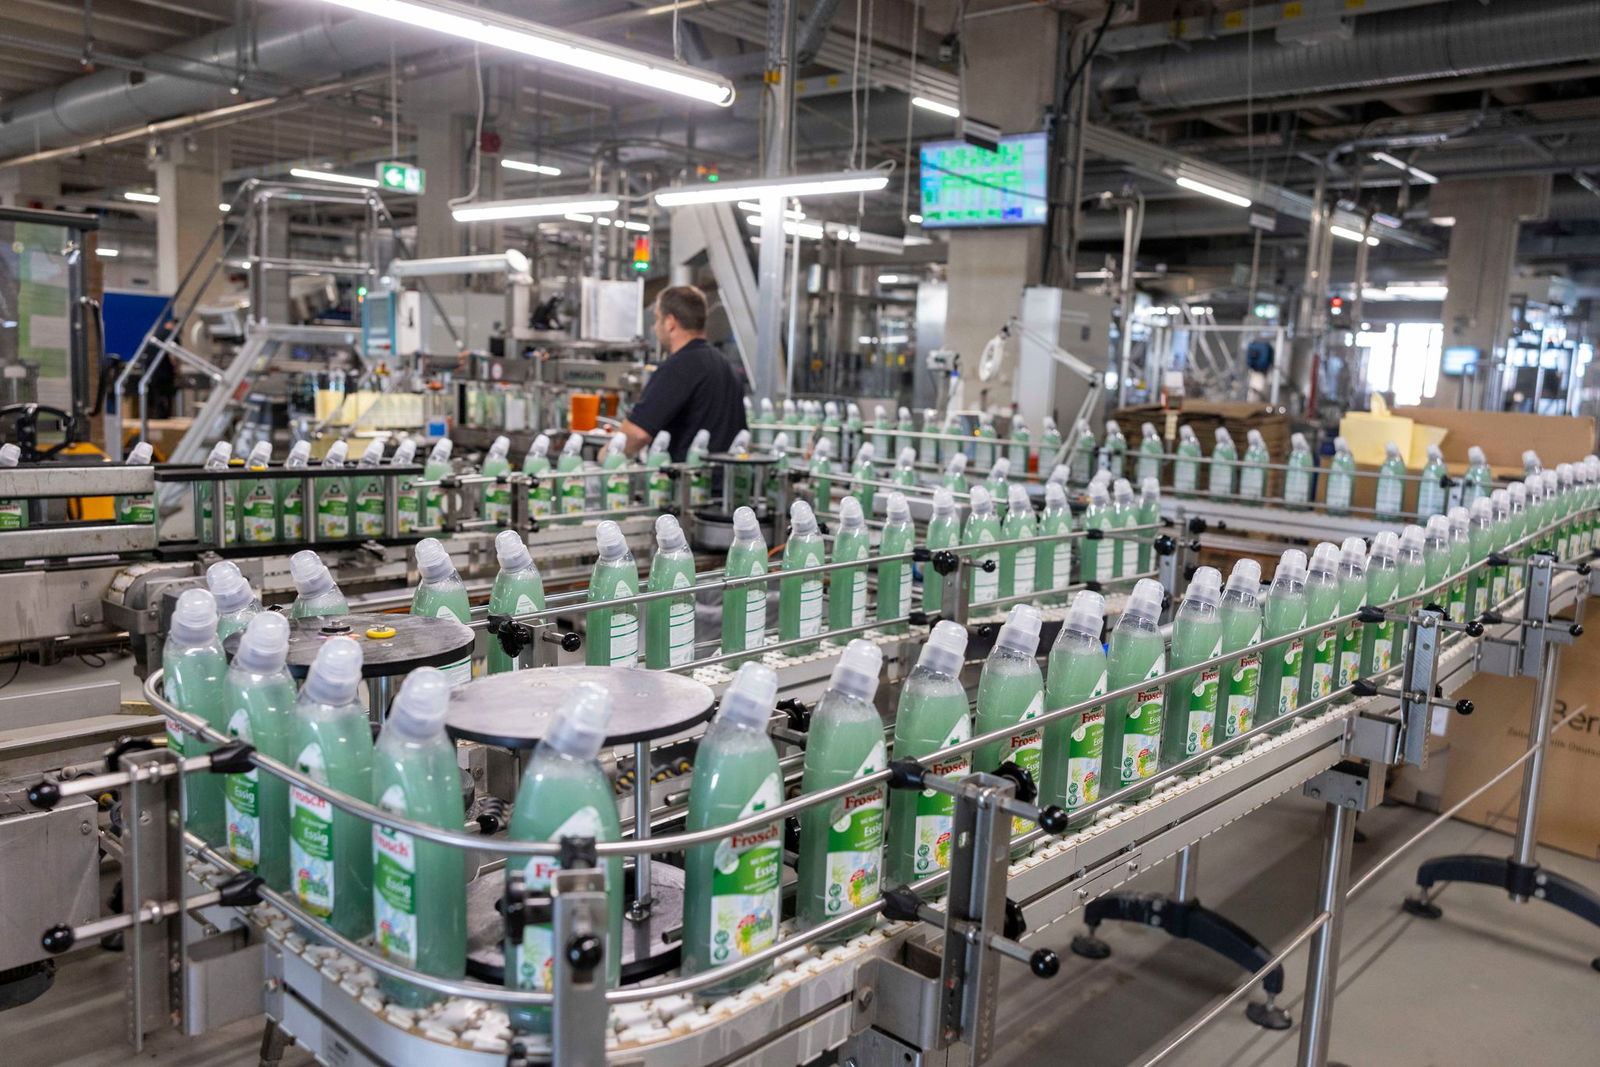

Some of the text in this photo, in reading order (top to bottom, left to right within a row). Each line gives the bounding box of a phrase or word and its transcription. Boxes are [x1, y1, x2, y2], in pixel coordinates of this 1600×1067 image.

[932, 759, 968, 776] Frosch
[845, 788, 883, 809] Frosch
[731, 825, 778, 848] Frosch
